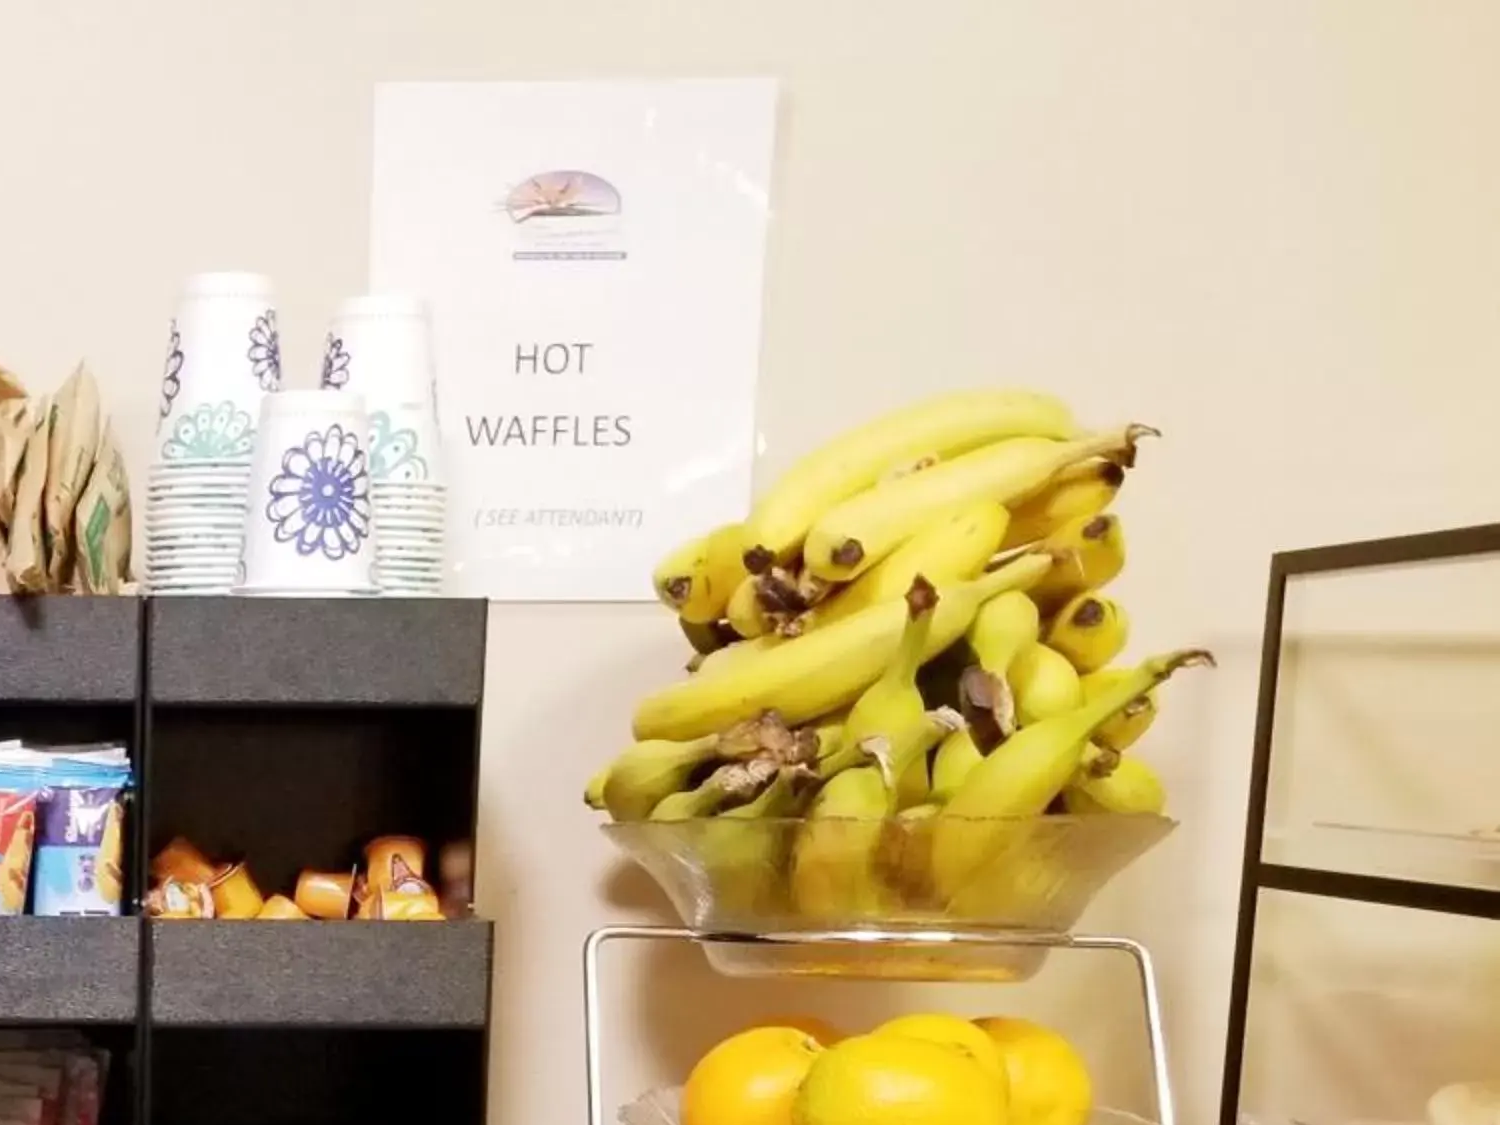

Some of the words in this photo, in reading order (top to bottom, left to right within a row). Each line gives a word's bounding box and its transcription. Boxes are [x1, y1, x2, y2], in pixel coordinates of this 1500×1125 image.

[515, 343, 594, 375] HOT
[466, 415, 632, 447] WAFFLES
[485, 508, 520, 527] SEE
